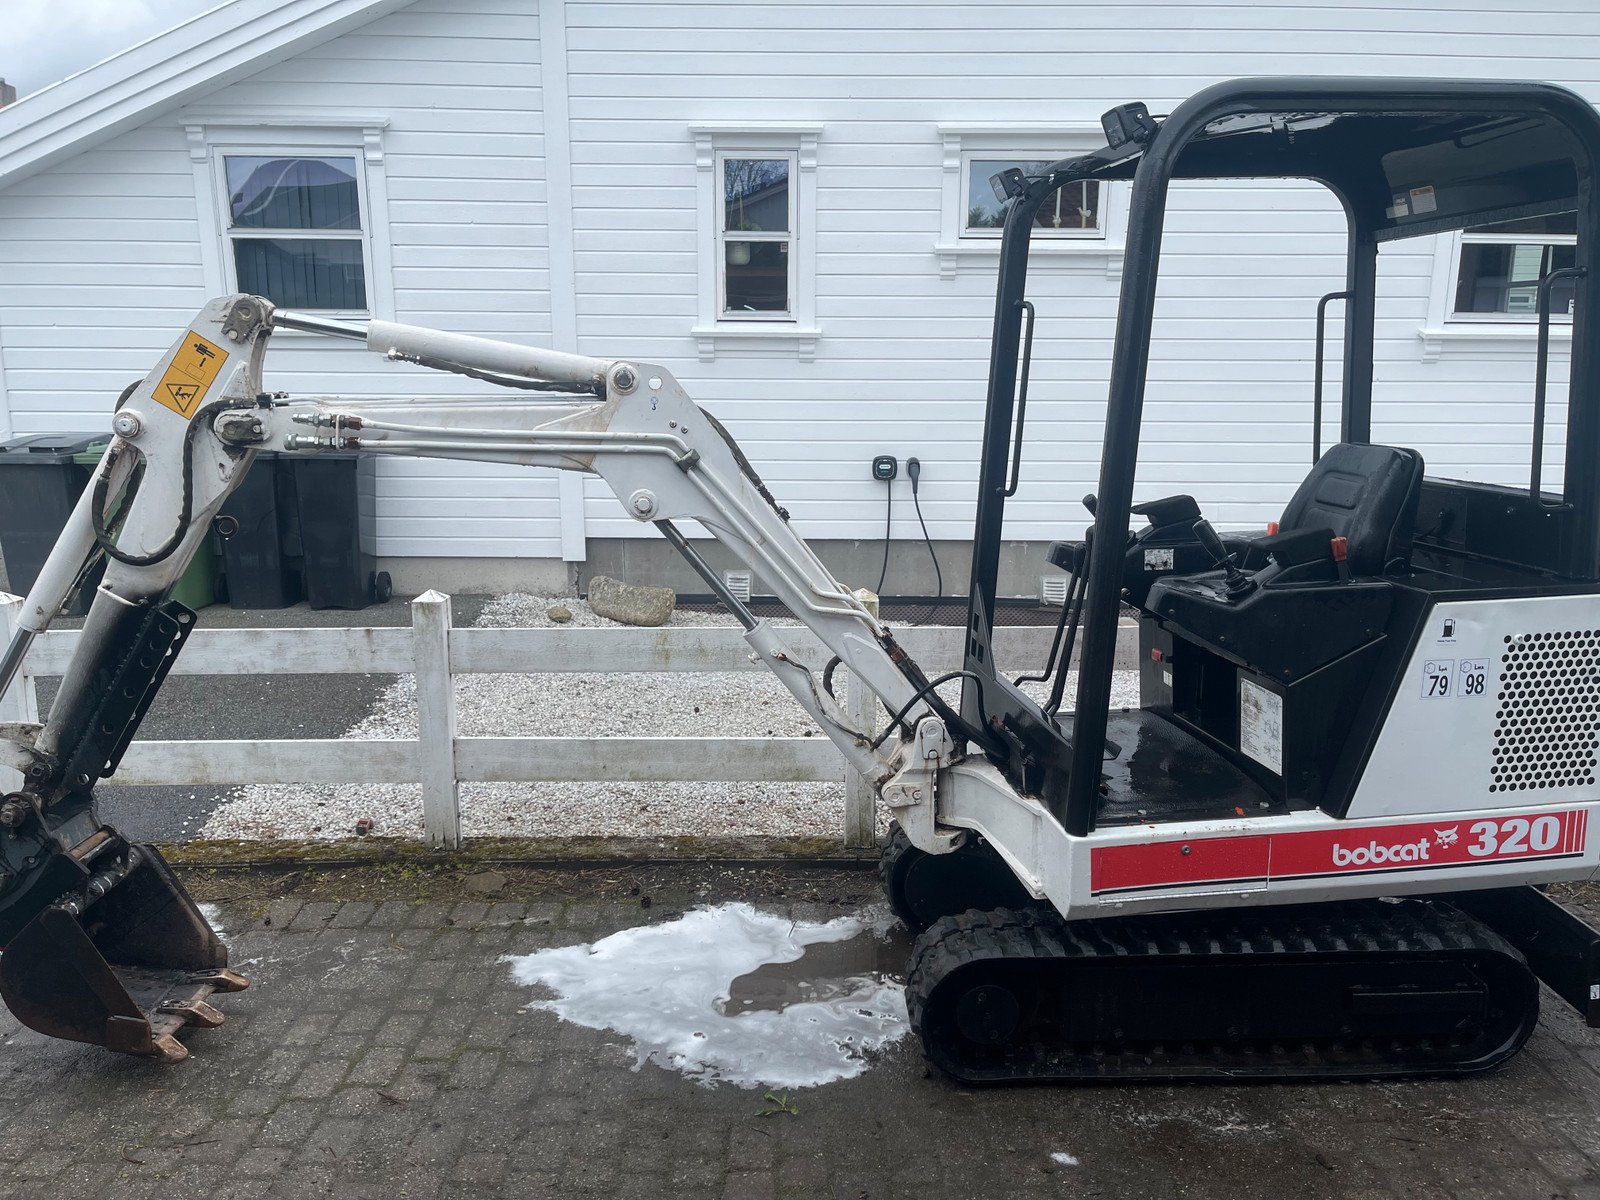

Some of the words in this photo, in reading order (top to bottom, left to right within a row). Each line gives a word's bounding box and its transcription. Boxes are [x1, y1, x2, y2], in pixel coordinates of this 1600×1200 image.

[1428, 675, 1448, 696] 79
[1465, 674, 1485, 695] 98
[1332, 838, 1430, 867] bobcat
[1467, 816, 1560, 857] 320
